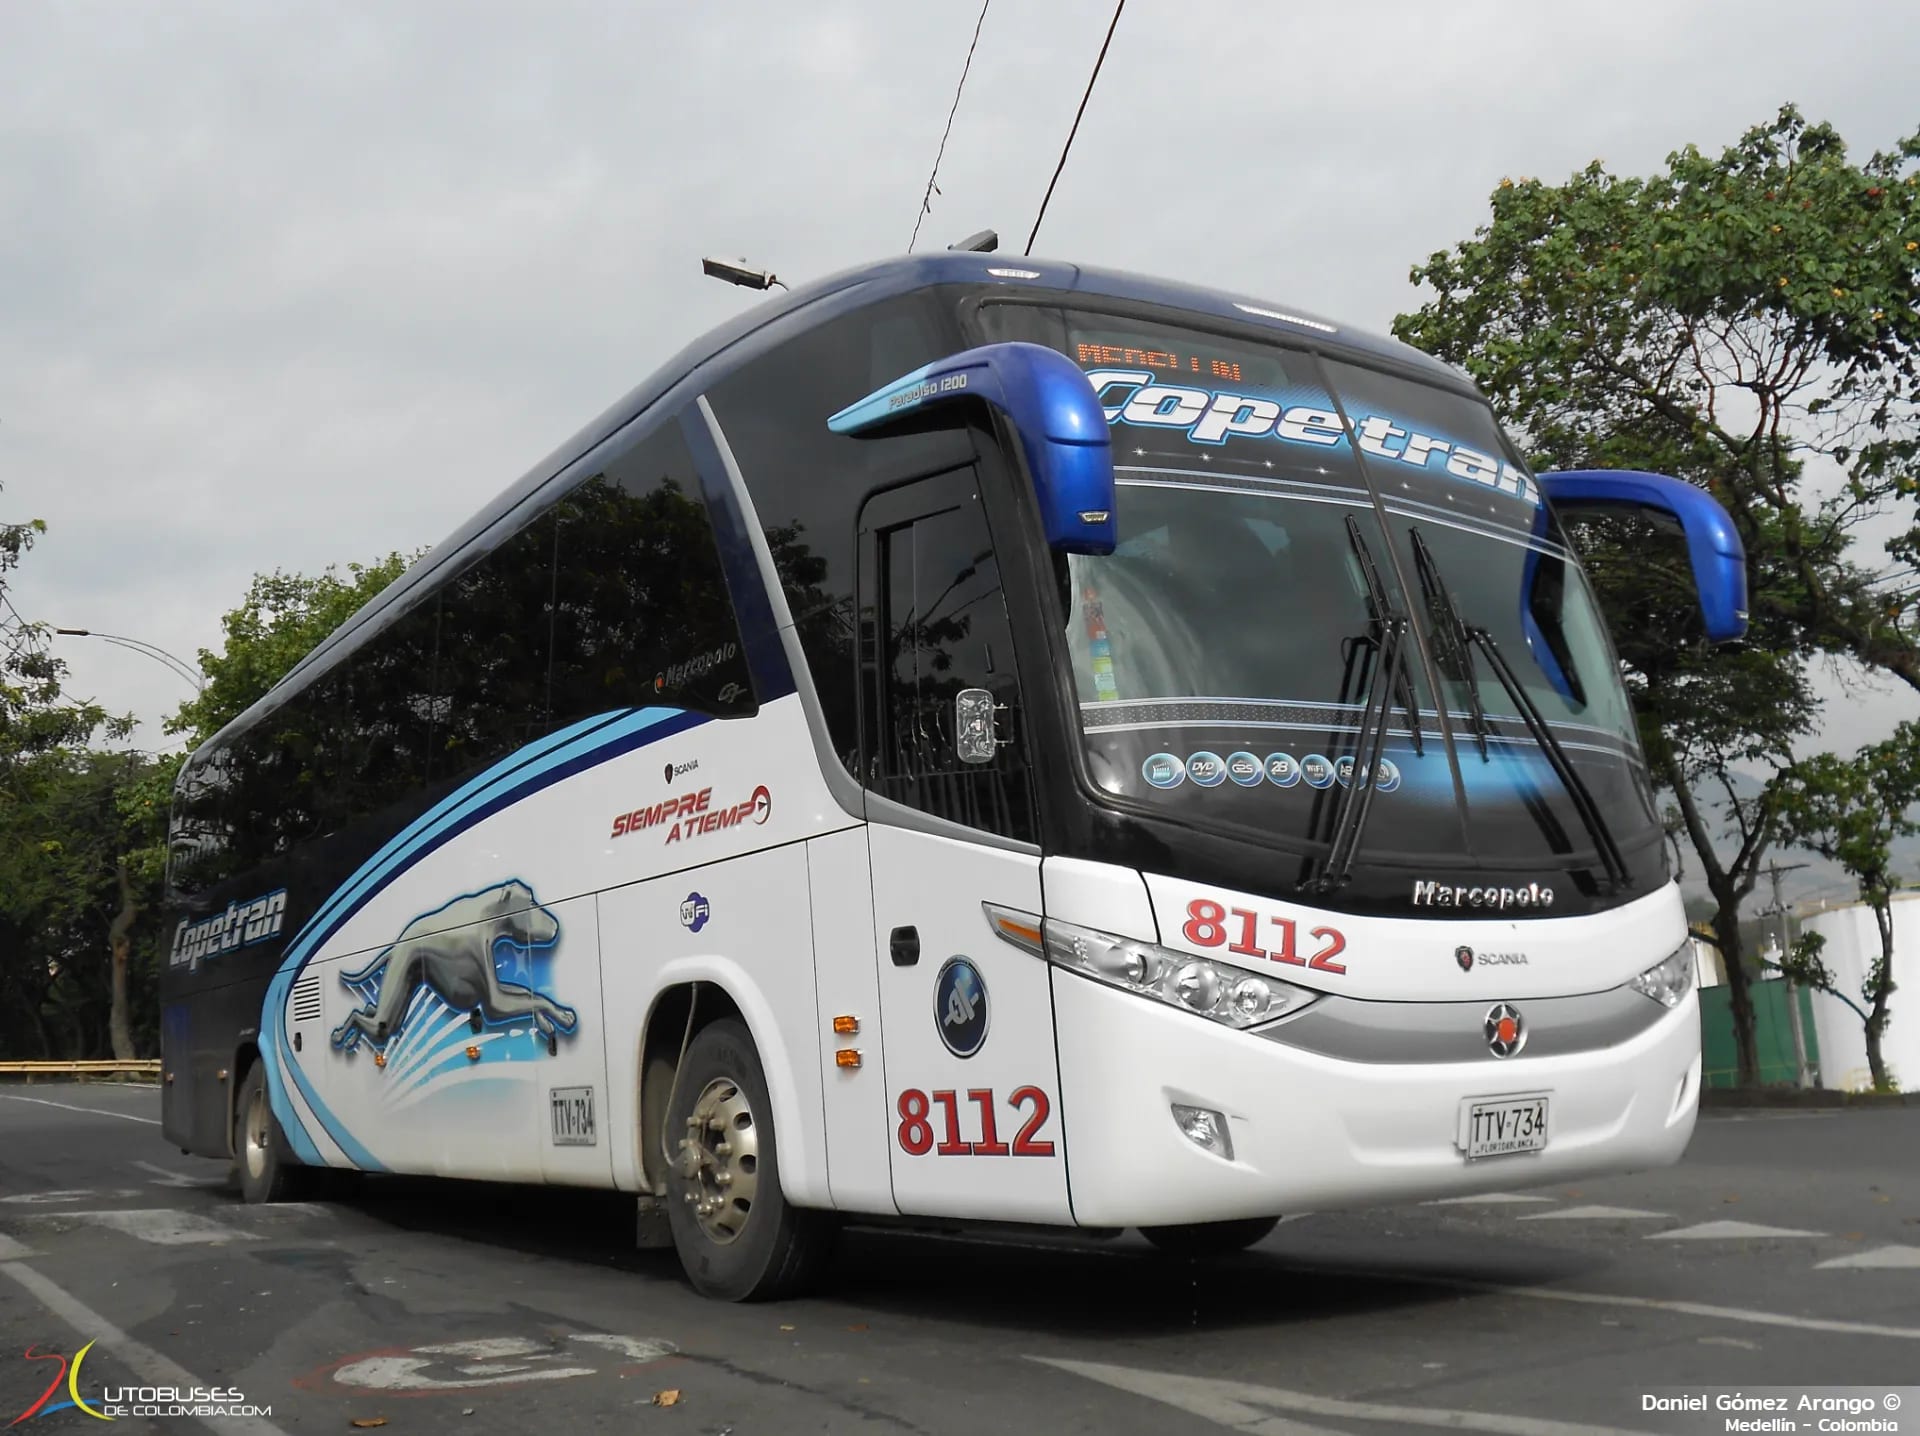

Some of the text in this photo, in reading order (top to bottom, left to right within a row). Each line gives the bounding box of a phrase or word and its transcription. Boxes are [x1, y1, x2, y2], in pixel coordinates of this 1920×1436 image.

[940, 373, 968, 392] 1200
[1085, 369, 1541, 506] Copetran
[674, 759, 699, 777] SCANIA
[1191, 761, 1216, 772] DVD
[610, 786, 713, 840] SIEMPRE
[1413, 880, 1555, 910] Marcopolo
[169, 889, 288, 974] Copetran
[1182, 898, 1347, 976] 8112
[1478, 953, 1529, 967] SCANIA
[897, 1085, 1056, 1157] 8112
